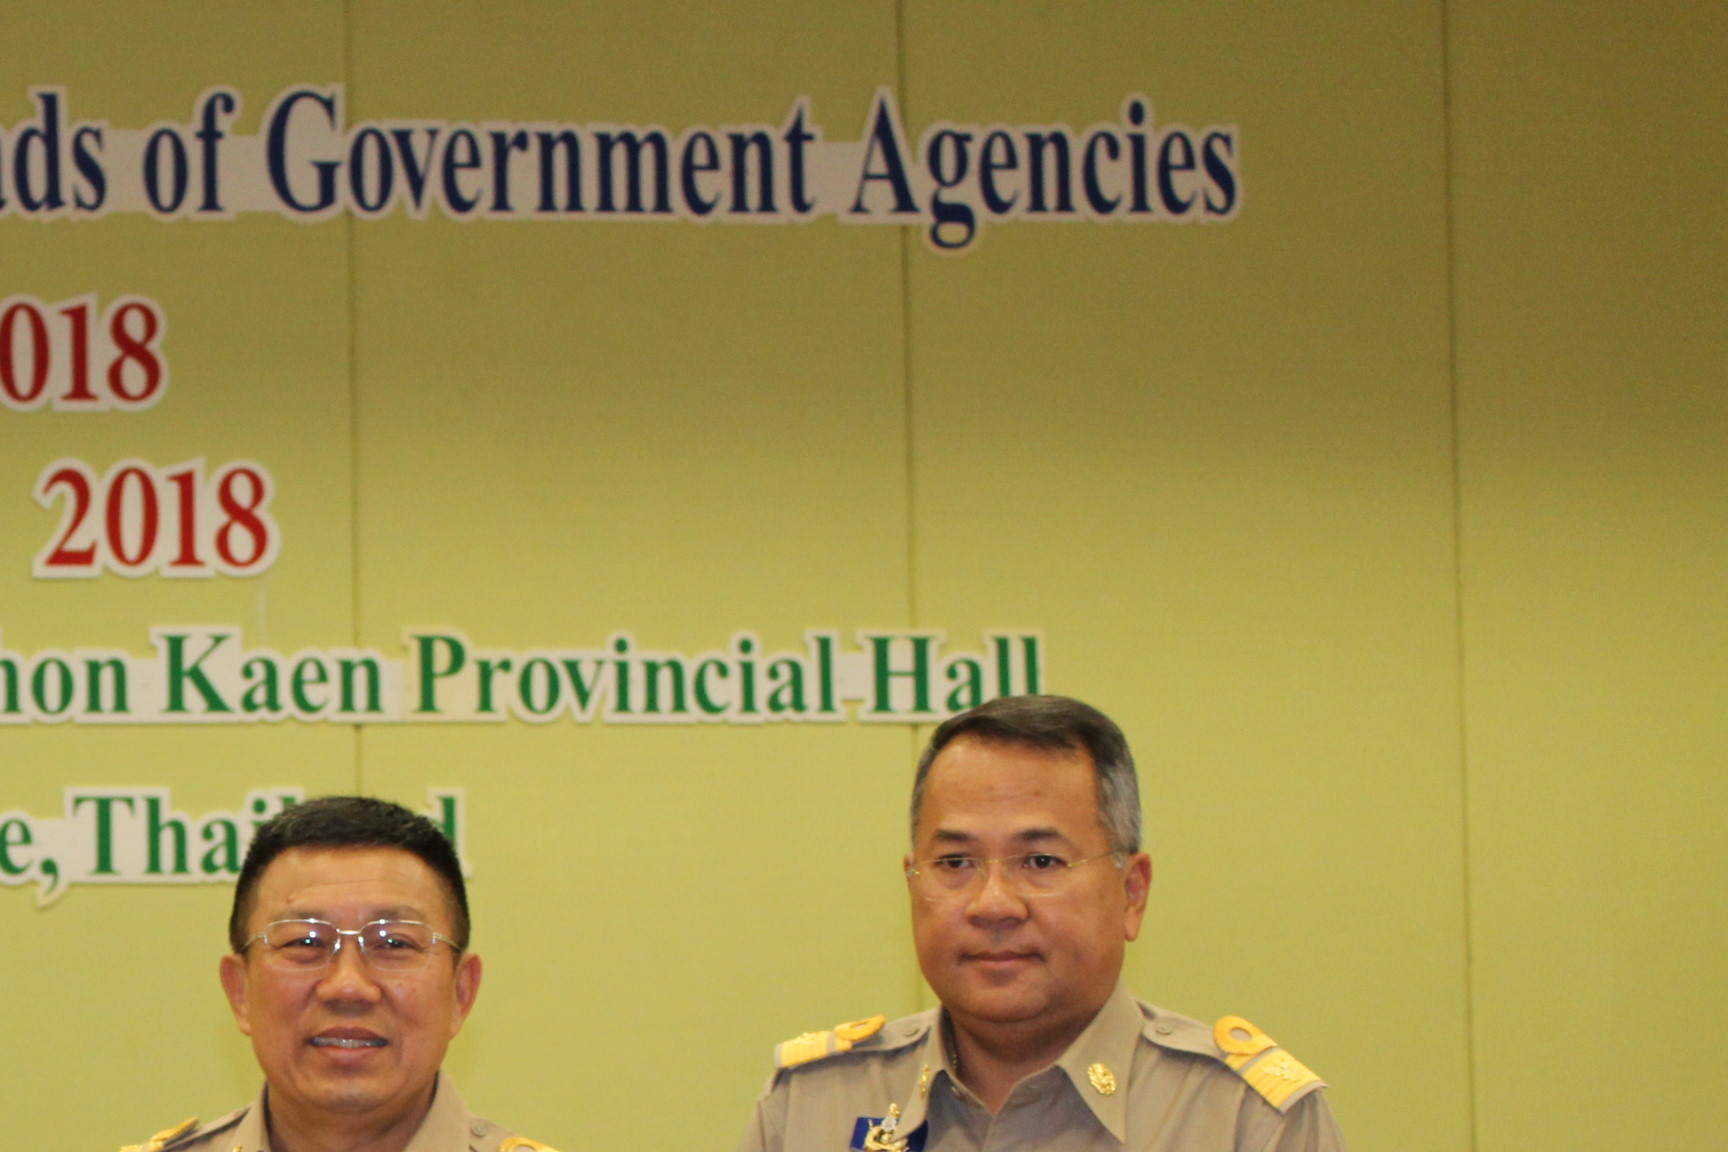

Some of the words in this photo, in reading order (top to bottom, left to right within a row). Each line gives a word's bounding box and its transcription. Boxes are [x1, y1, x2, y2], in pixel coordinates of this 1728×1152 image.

[142, 92, 236, 215] of
[266, 90, 817, 217] Government
[849, 97, 1238, 250] Agencies
[42, 465, 270, 568] 2018
[162, 632, 383, 716] Kaen
[415, 632, 839, 716] Provincial
[866, 633, 1041, 713] Hall
